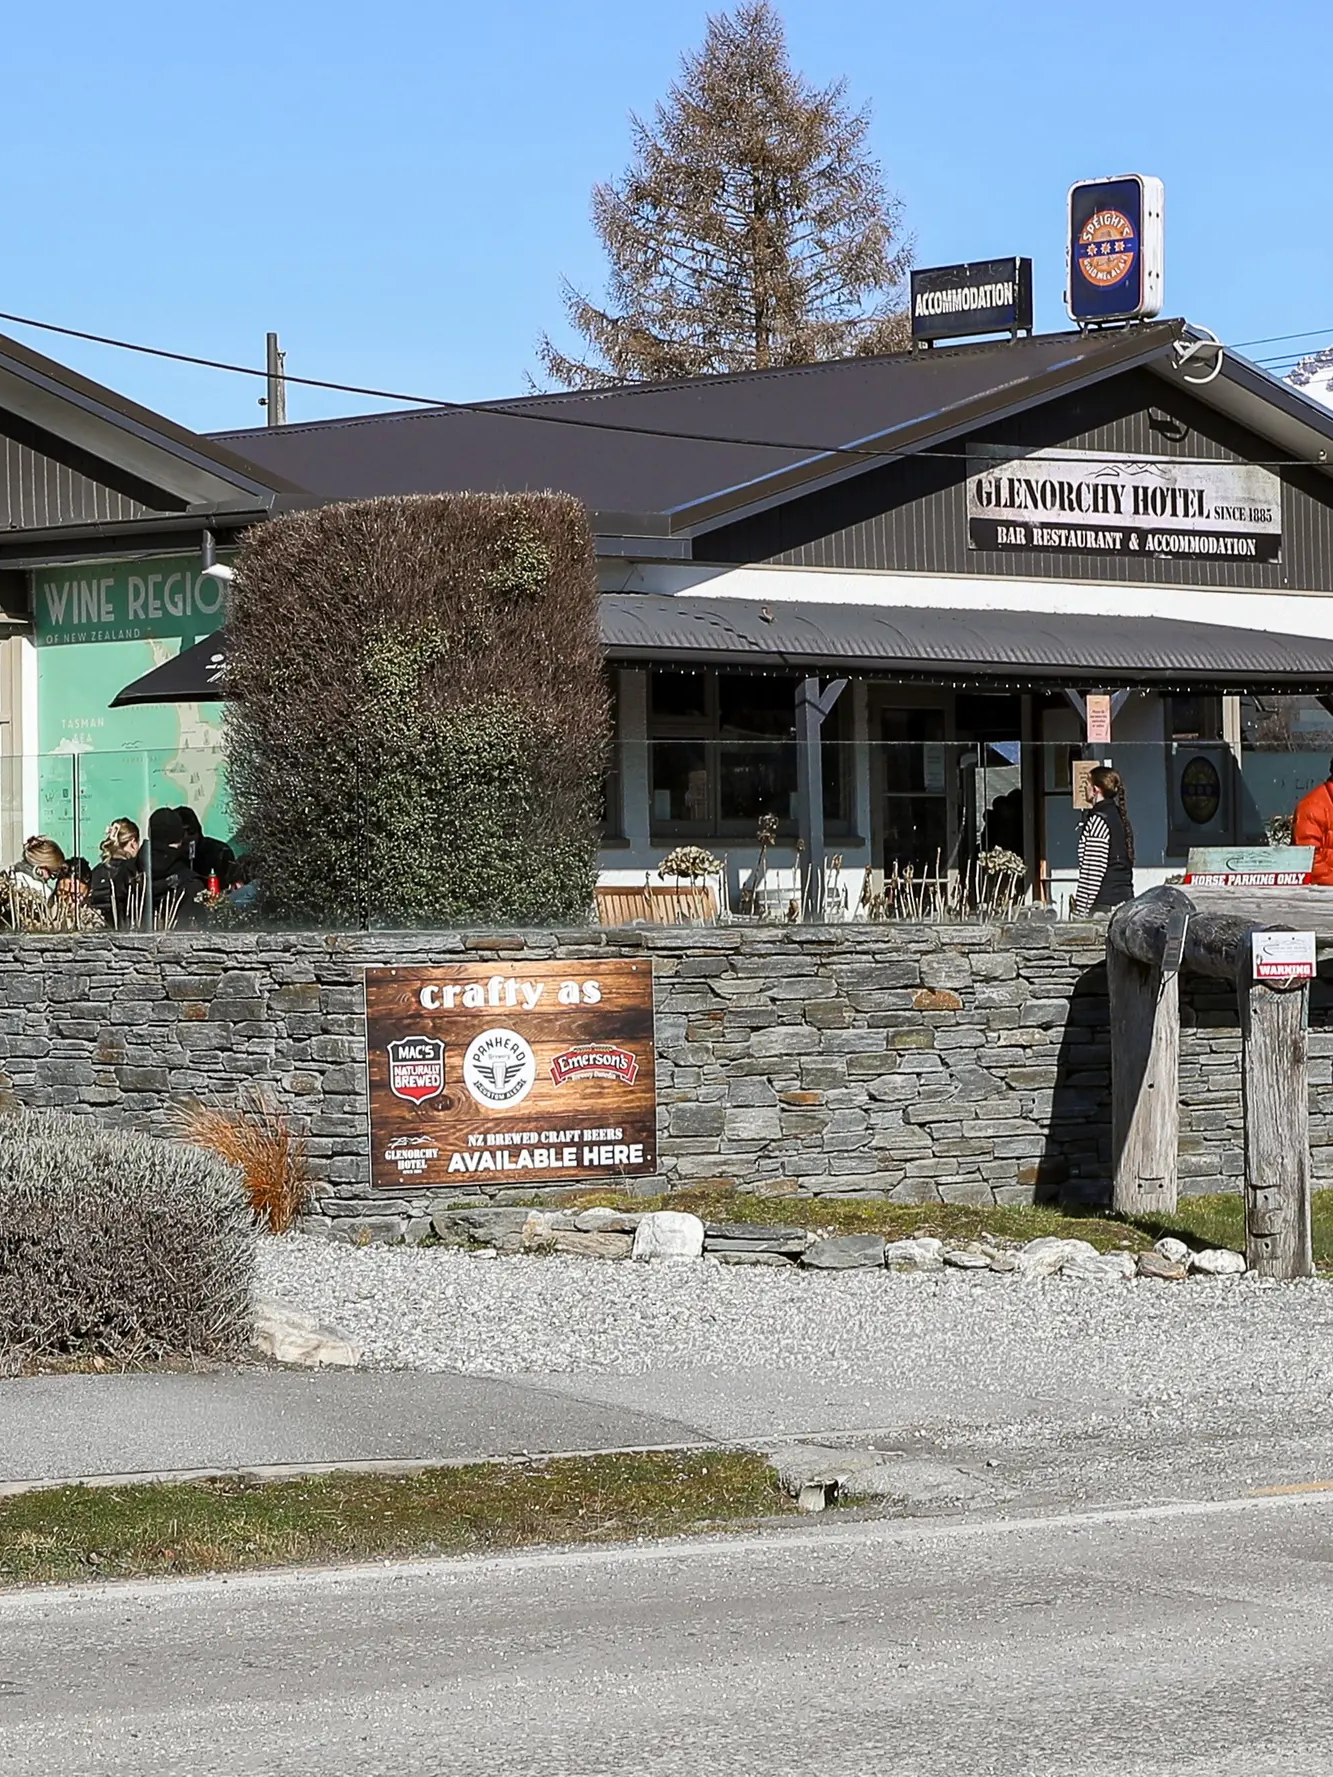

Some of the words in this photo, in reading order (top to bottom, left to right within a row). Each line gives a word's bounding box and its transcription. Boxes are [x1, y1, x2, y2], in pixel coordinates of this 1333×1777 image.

[1082, 213, 1130, 241] SPEIGHT'S
[915, 281, 1013, 317] ACCOMMODATION
[975, 476, 1126, 515] GLENORCHY
[1132, 483, 1210, 519] HOTEL
[1213, 504, 1246, 522] SINCE
[1248, 506, 1272, 523] 1885
[997, 526, 1026, 545] BAR
[1033, 528, 1123, 550] RESTAURANT
[1128, 533, 1140, 550] &
[1145, 534, 1256, 556] ACCOMMODATION
[44, 577, 115, 626] WINE
[128, 571, 224, 620] REGIO
[45, 633, 59, 645] OF
[63, 631, 87, 643] NEW
[91, 628, 141, 641] ZEALAND
[61, 716, 105, 730] TASMAN
[1190, 874, 1225, 886] HORSE
[1228, 873, 1275, 885] PARKING
[1277, 873, 1305, 885] ONLY
[1259, 964, 1311, 975] WARNING
[420, 975, 545, 1010] crafty
[557, 980, 602, 1004] as
[398, 1045, 434, 1060] MAC'S
[472, 1036, 526, 1063] PANHEAD
[394, 1064, 440, 1076] NATURALLY
[557, 1053, 629, 1073] Emerson's
[394, 1074, 440, 1088] BREWED
[467, 1133, 485, 1147] NZ
[487, 1132, 539, 1146] BREWED
[541, 1131, 581, 1144] CRAFT
[583, 1128, 623, 1142] BEERS
[384, 1148, 438, 1160] GLENORCHY
[447, 1147, 577, 1173] AVAILABLE
[582, 1144, 644, 1166] HERE
[398, 1159, 427, 1171] HOTEL
